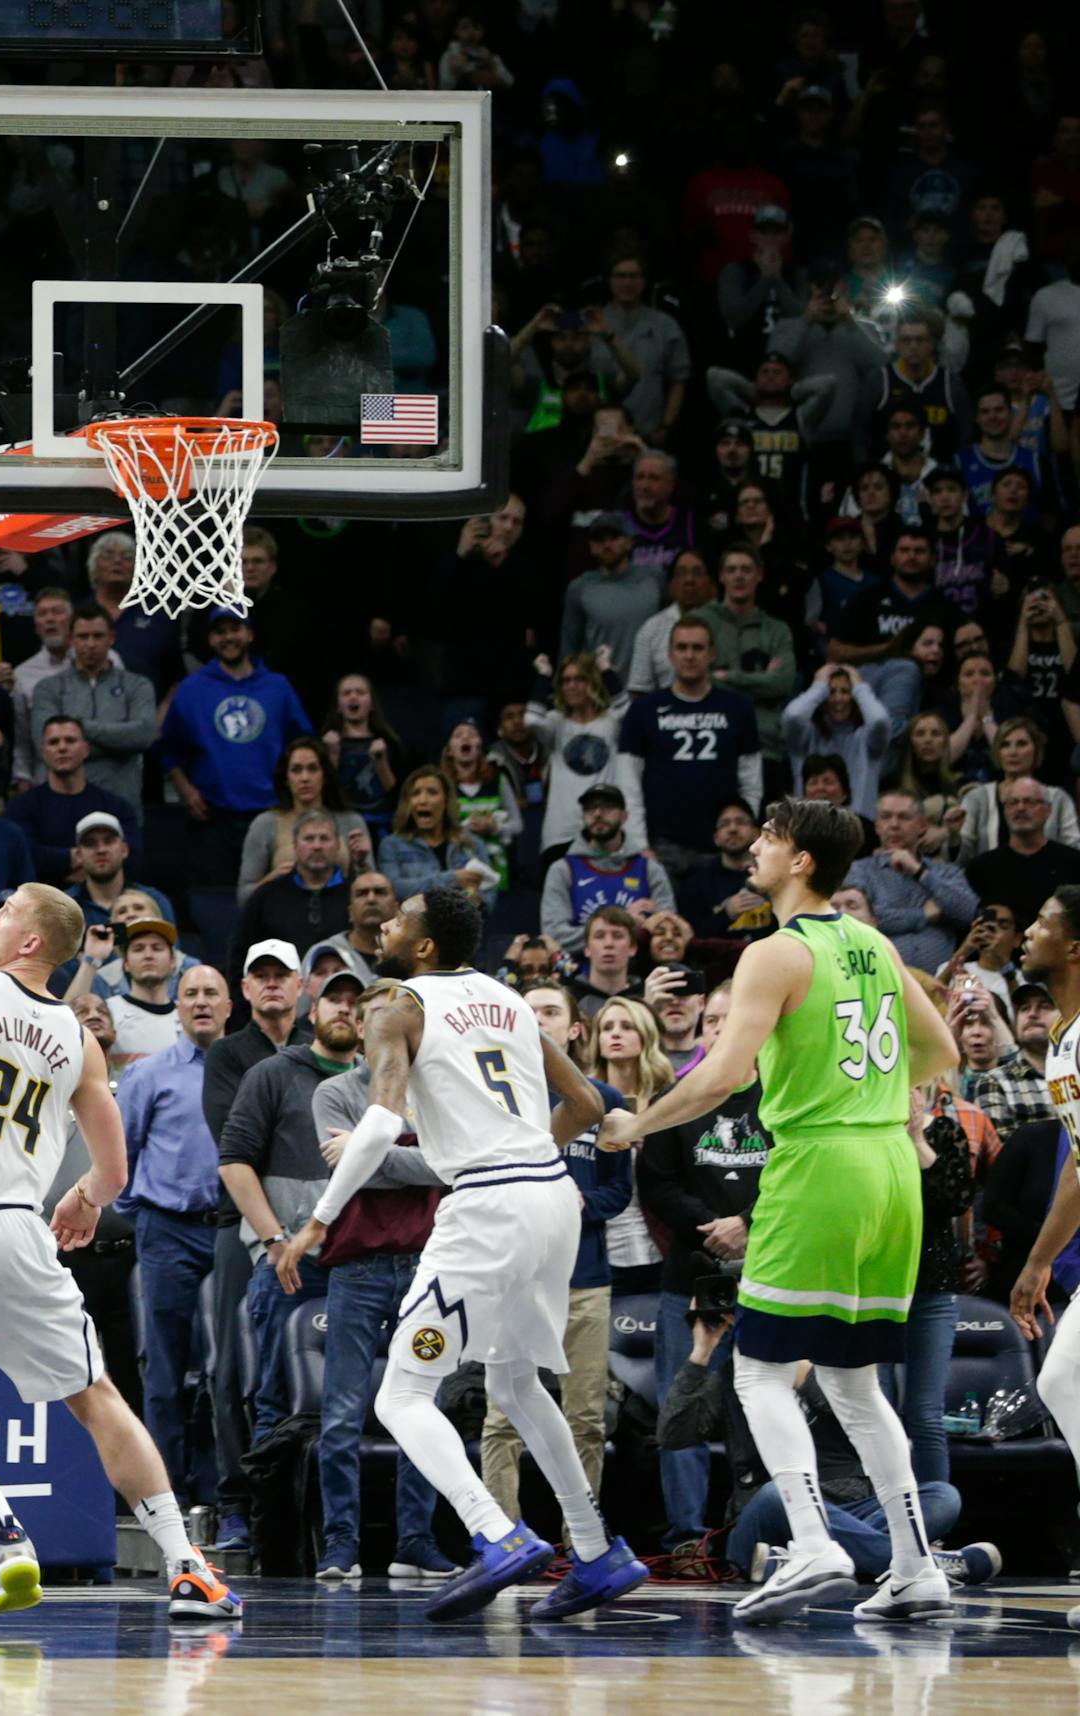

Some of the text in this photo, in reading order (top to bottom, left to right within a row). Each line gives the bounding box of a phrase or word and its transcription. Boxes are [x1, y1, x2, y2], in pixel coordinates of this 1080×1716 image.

[1031, 671, 1059, 698] 32
[672, 730, 718, 761] 22
[444, 1003, 518, 1036] BARTON
[835, 991, 900, 1081] 36
[472, 1048, 522, 1119] 5
[954, 1320, 1004, 1331] EXUS
